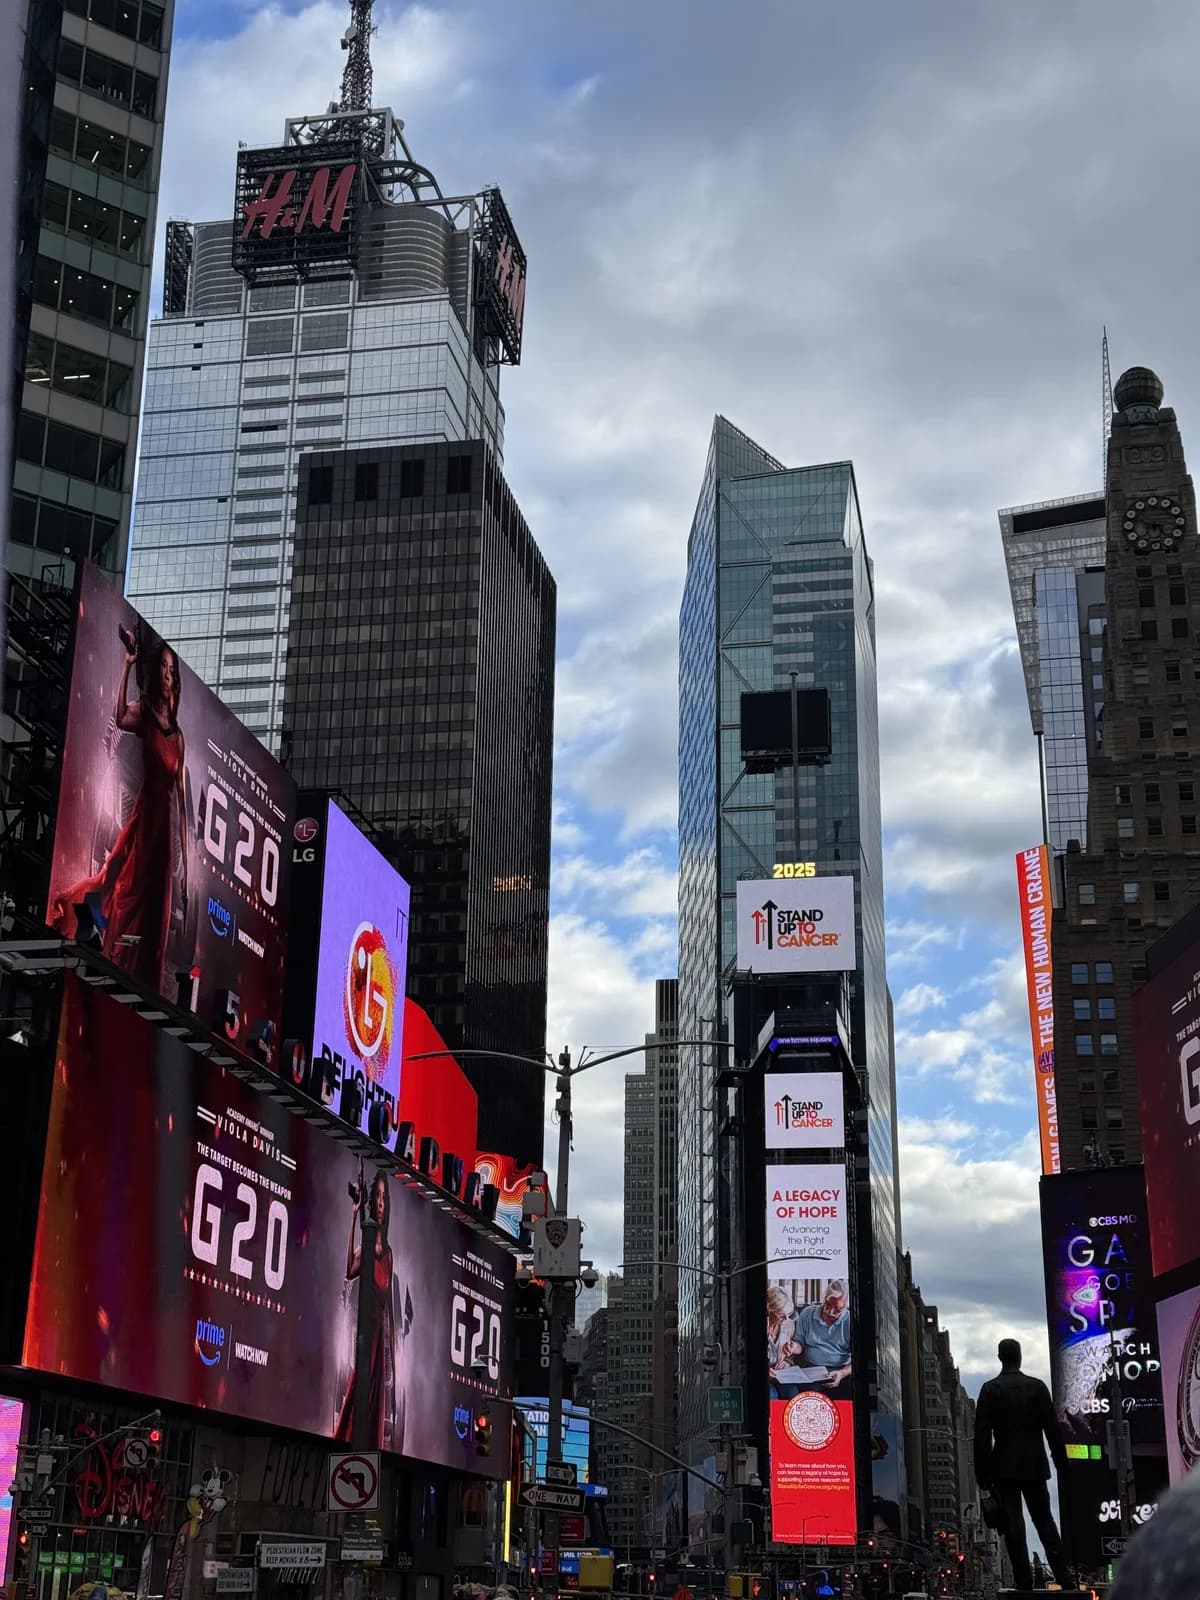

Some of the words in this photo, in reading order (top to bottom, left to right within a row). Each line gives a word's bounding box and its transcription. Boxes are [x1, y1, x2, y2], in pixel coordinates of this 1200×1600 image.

[242, 163, 357, 240] H&M
[207, 765, 217, 780] THE
[217, 772, 235, 797] TARGET
[234, 792, 256, 817] BECOMES
[223, 752, 247, 784] VIOLA
[250, 781, 273, 809] DAVIS
[204, 783, 280, 907] G20
[292, 848, 315, 863] LG
[773, 862, 816, 878] 2025
[1024, 845, 1040, 903] CRANE
[208, 897, 231, 926] prime
[777, 909, 823, 922] STAND
[777, 933, 839, 947] CANCER
[1027, 906, 1049, 967] HUMAN
[1035, 971, 1053, 1015] NEW
[810, 1037, 832, 1045] square
[1040, 1015, 1054, 1048] THE
[226, 1106, 245, 1125] ACADEMY
[792, 1101, 823, 1111] STAND
[1045, 1077, 1059, 1137] GAMES
[792, 1118, 833, 1128] CANCER
[217, 1114, 248, 1143] VIOLA
[252, 1135, 281, 1161] DAVIS
[196, 1141, 209, 1157] THE
[209, 1148, 232, 1169] TARGET
[232, 1160, 259, 1184] BECOMES
[259, 1174, 270, 1190] THE
[269, 1180, 292, 1201] WEAPON
[772, 1191, 783, 1202] A
[785, 1190, 840, 1202] LEGACY
[776, 1207, 795, 1218] OF
[799, 1206, 837, 1218] HOPE
[1098, 1216, 1118, 1226] CBS
[191, 1163, 289, 1291] G20
[782, 1225, 830, 1236] Advancing
[774, 1247, 806, 1257] Against
[808, 1247, 841, 1256] Cancer
[804, 1236, 824, 1246] Fight
[196, 1317, 225, 1347] prime
[450, 1294, 501, 1380] G20
[235, 1342, 254, 1363] WATCH
[253, 1348, 269, 1367] NOW
[540, 1320, 550, 1368] 1500
[1080, 1398, 1110, 1414] CBS
[528, 1490, 547, 1501] ONE
[556, 1494, 576, 1505] WAY
[266, 1556, 278, 1564] KEEP
[279, 1556, 298, 1564] MOVING
